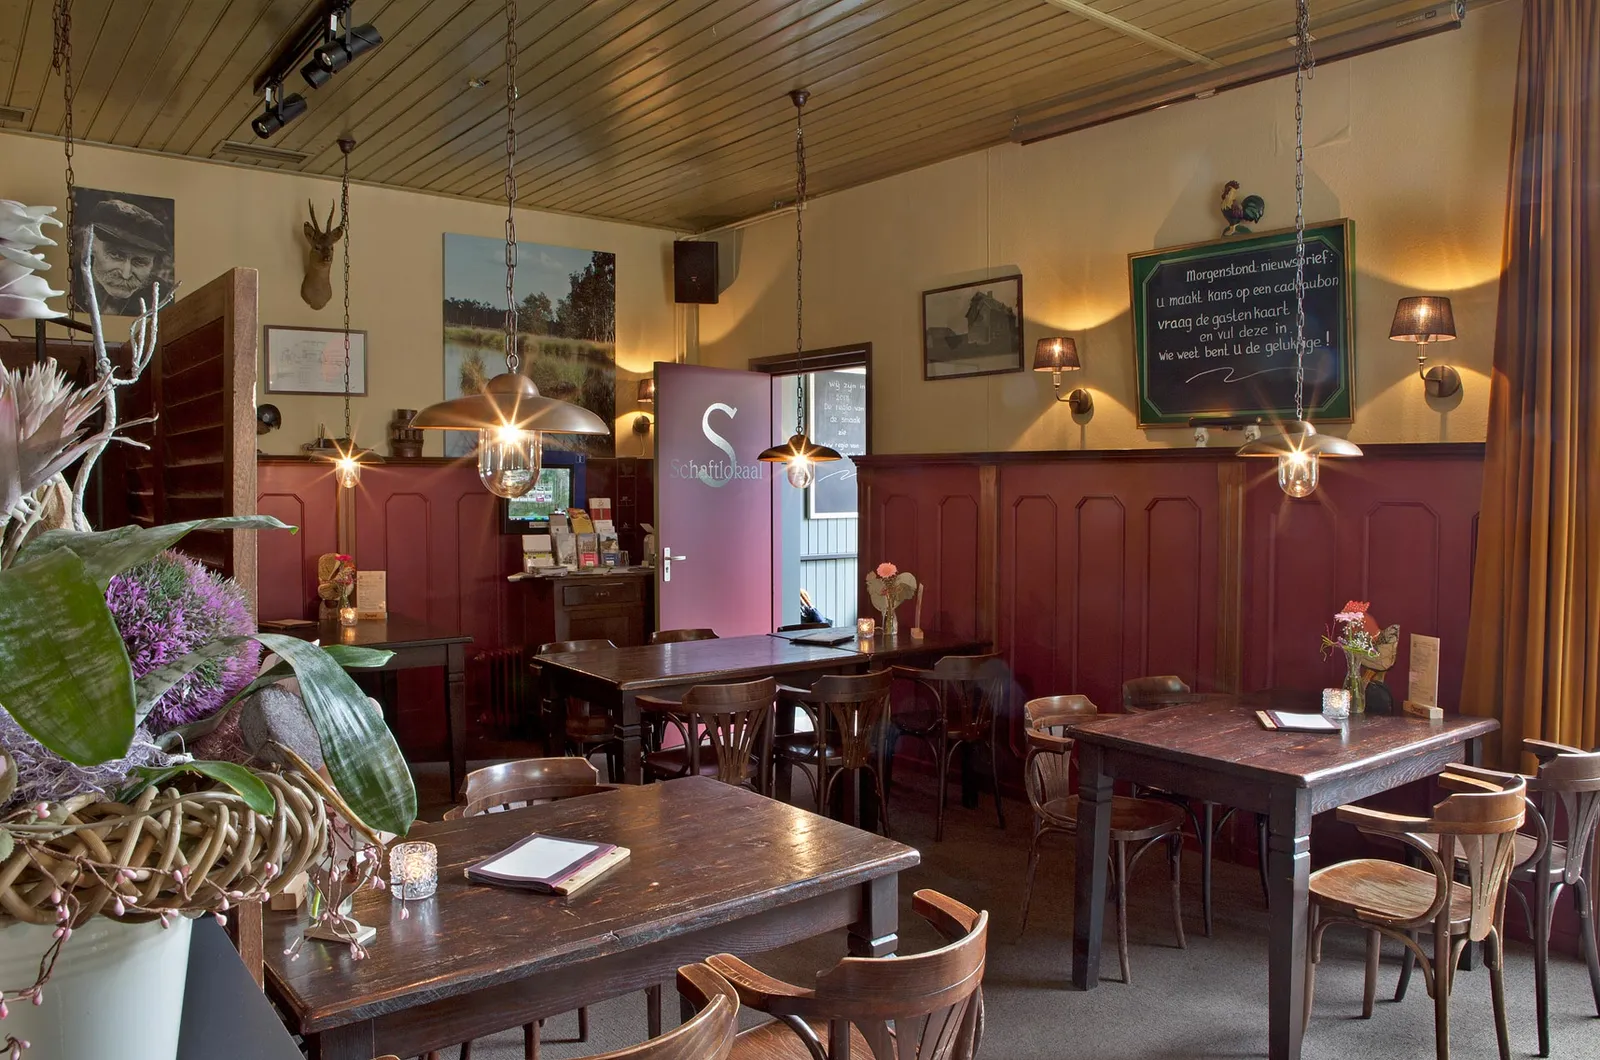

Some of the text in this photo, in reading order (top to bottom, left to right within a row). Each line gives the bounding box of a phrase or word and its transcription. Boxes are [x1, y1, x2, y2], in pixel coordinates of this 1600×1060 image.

[1169, 290, 1203, 307] maakt
[1208, 288, 1233, 302] kans
[1236, 287, 1250, 303] op
[1253, 286, 1271, 296] een
[1157, 317, 1192, 333] vraag
[1195, 313, 1210, 327] de
[1200, 332, 1213, 343] en
[1217, 327, 1234, 339] vul
[1239, 324, 1268, 337] deze
[1176, 346, 1200, 360] weet
[1205, 343, 1230, 358] bent
[1245, 341, 1261, 355] de
[1265, 336, 1322, 357] gelukige
[670, 458, 763, 480] Schaftlokaal
